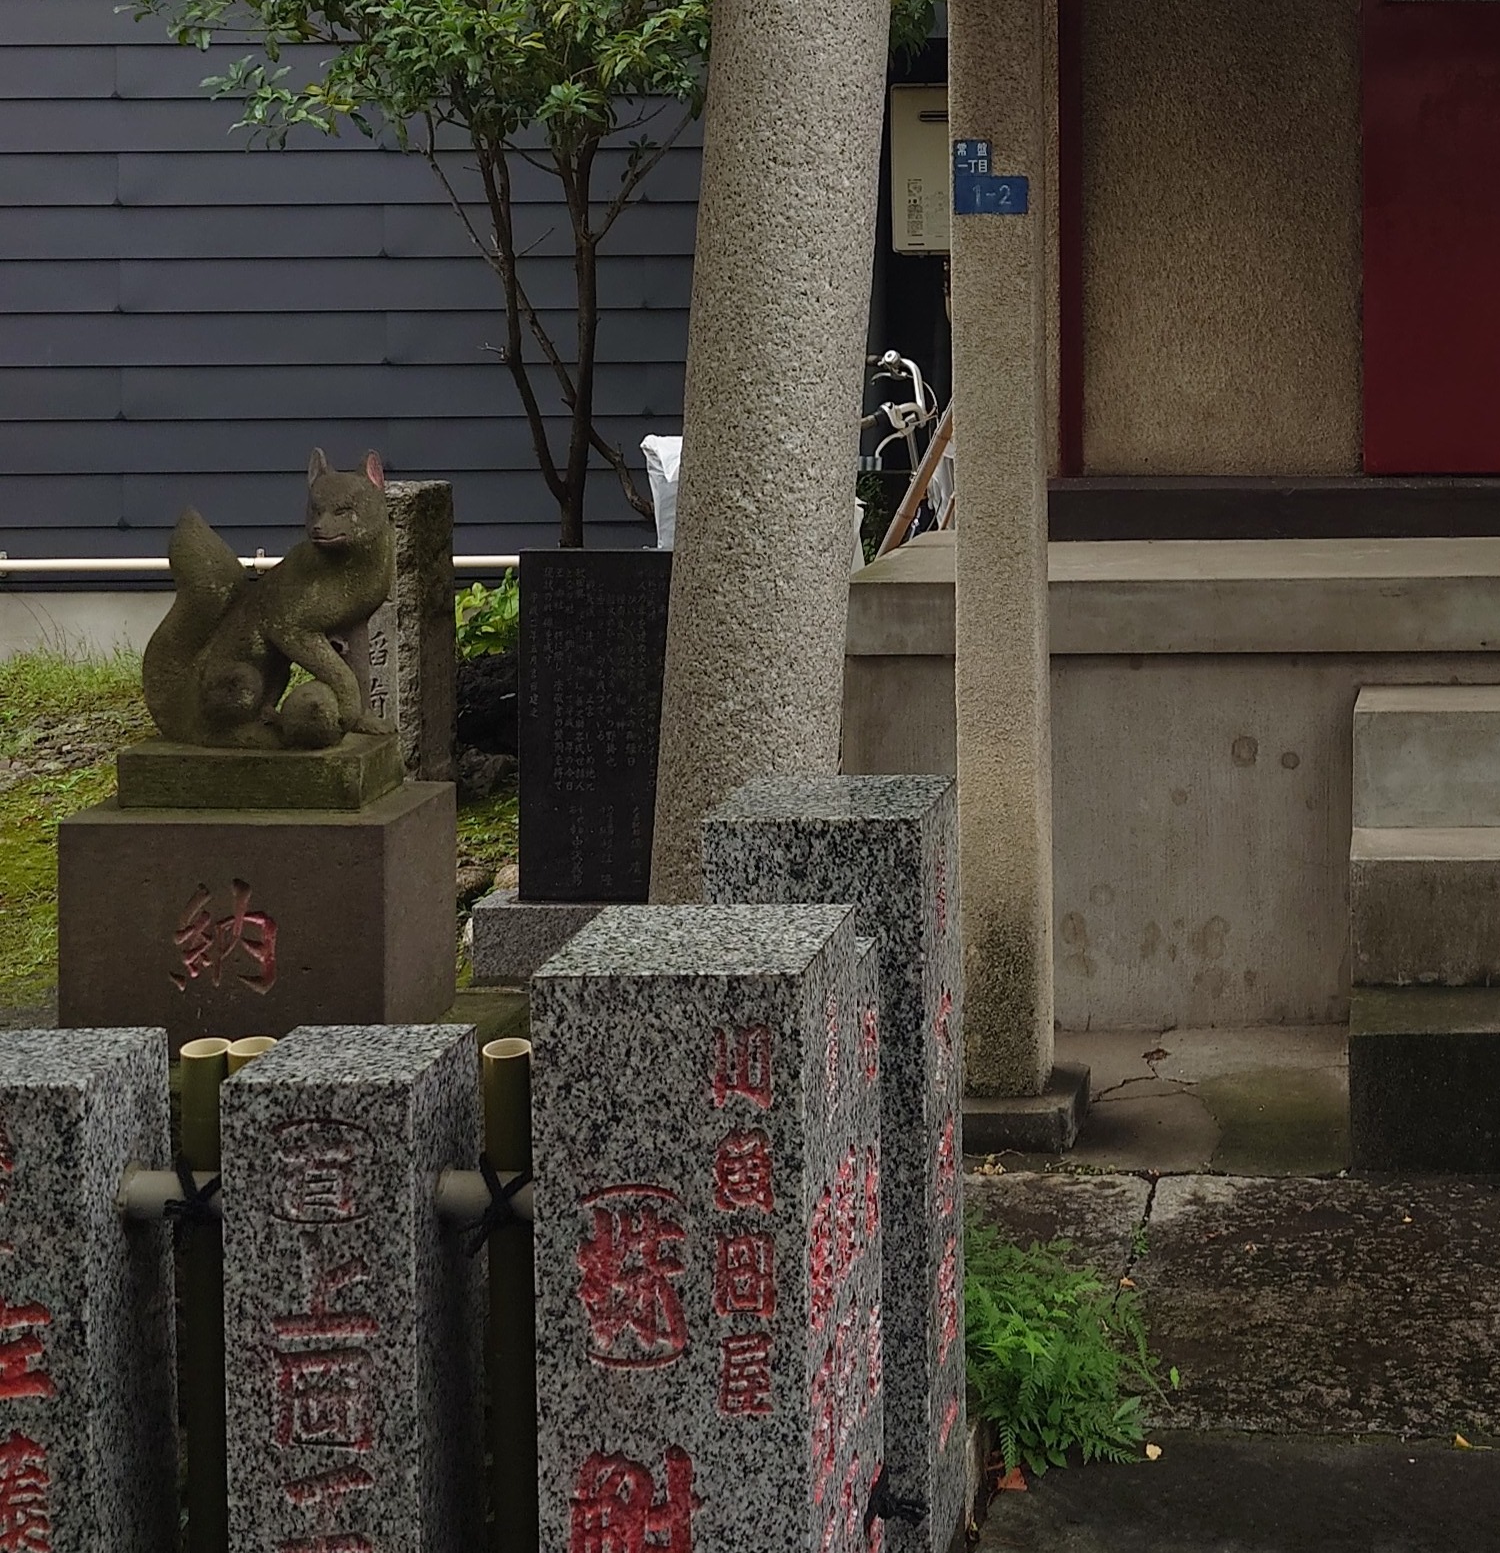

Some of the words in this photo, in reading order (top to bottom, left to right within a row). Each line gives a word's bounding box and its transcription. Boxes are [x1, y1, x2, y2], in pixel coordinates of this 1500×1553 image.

[956, 142, 988, 157] 常盤
[957, 159, 989, 174] 一丁目
[972, 184, 1013, 207] 1-2
[169, 877, 277, 995] 納
